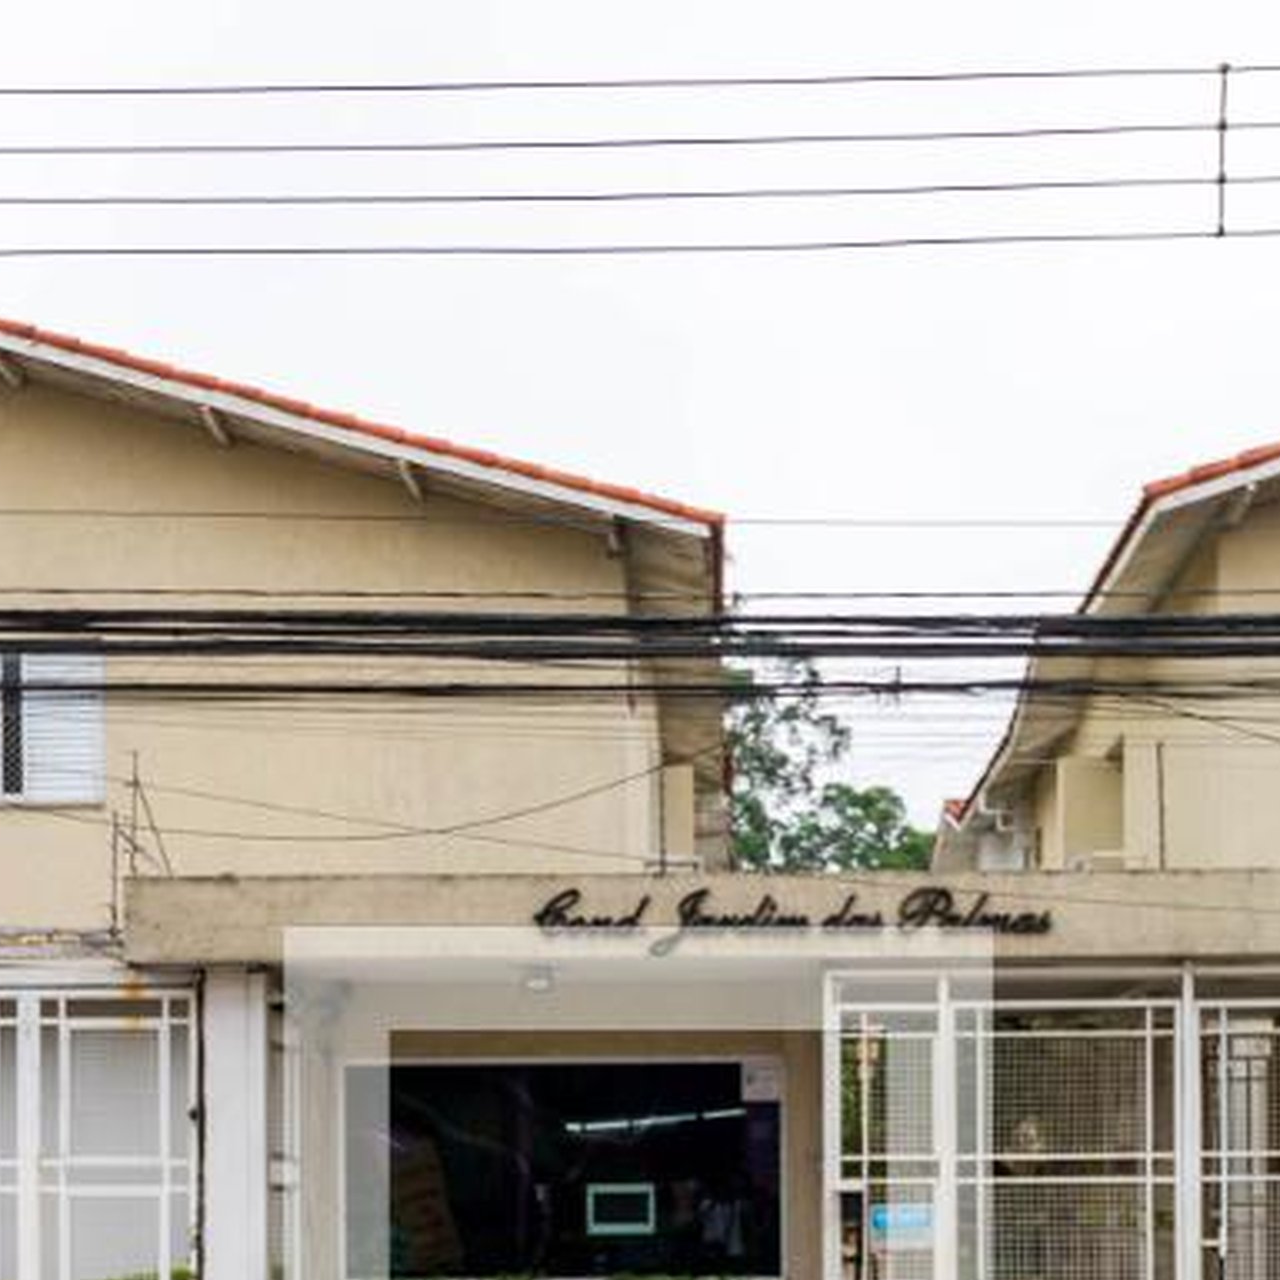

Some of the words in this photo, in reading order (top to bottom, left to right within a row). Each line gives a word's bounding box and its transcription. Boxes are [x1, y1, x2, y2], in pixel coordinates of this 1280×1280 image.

[649, 888, 808, 957] Jardim
[822, 894, 884, 933] das
[898, 887, 1052, 934] Palmas
